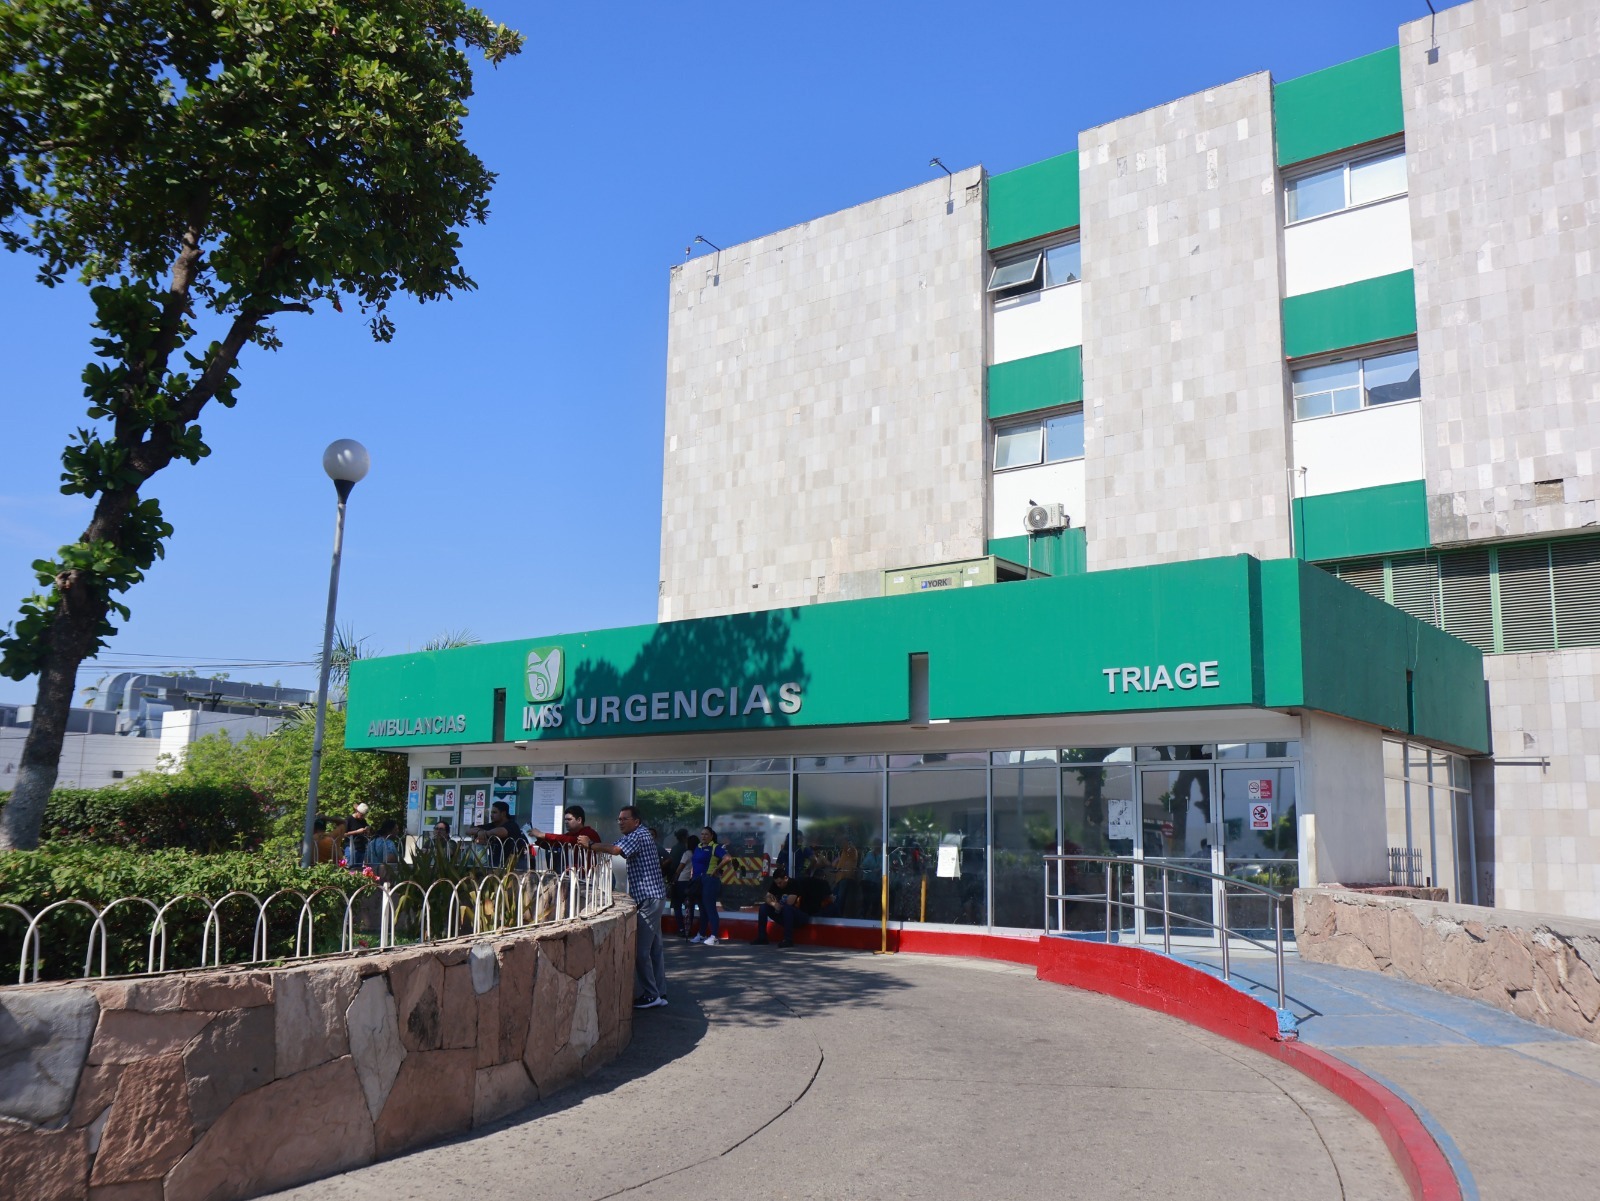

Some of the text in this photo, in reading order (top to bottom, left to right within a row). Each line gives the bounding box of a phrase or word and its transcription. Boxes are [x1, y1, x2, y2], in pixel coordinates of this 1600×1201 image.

[927, 578, 948, 588] YORK
[1102, 660, 1220, 694] TRIAGE
[522, 703, 563, 730] IMSS
[576, 682, 802, 725] URGENCIAS
[368, 714, 466, 737] AMBULANCIAS
